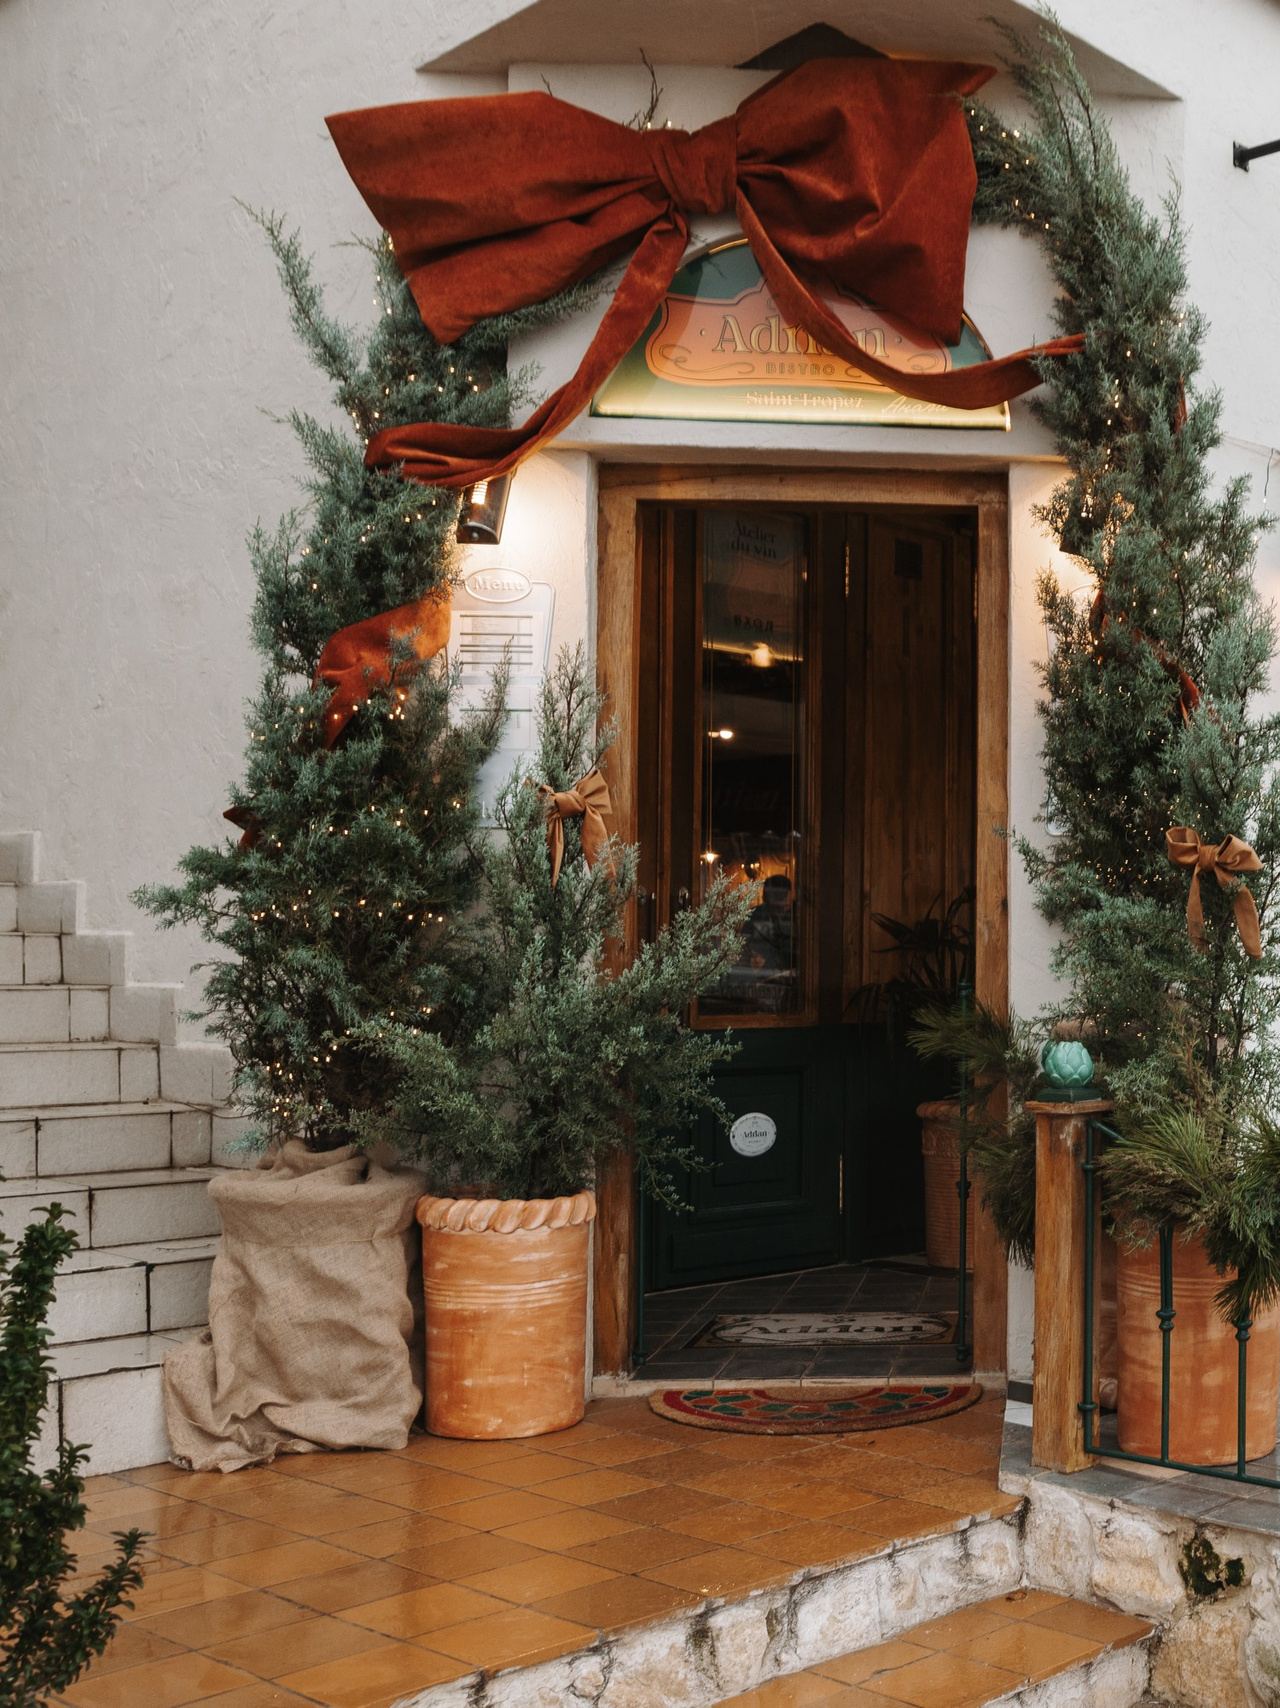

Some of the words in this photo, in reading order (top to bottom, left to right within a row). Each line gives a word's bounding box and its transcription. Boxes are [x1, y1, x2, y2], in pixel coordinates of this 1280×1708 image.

[711, 314, 889, 359] Adrin
[765, 361, 836, 376] BISTRO
[745, 390, 864, 411] Saint-Tropez
[472, 575, 526, 591] Menu
[742, 1129, 768, 1139] Adrian
